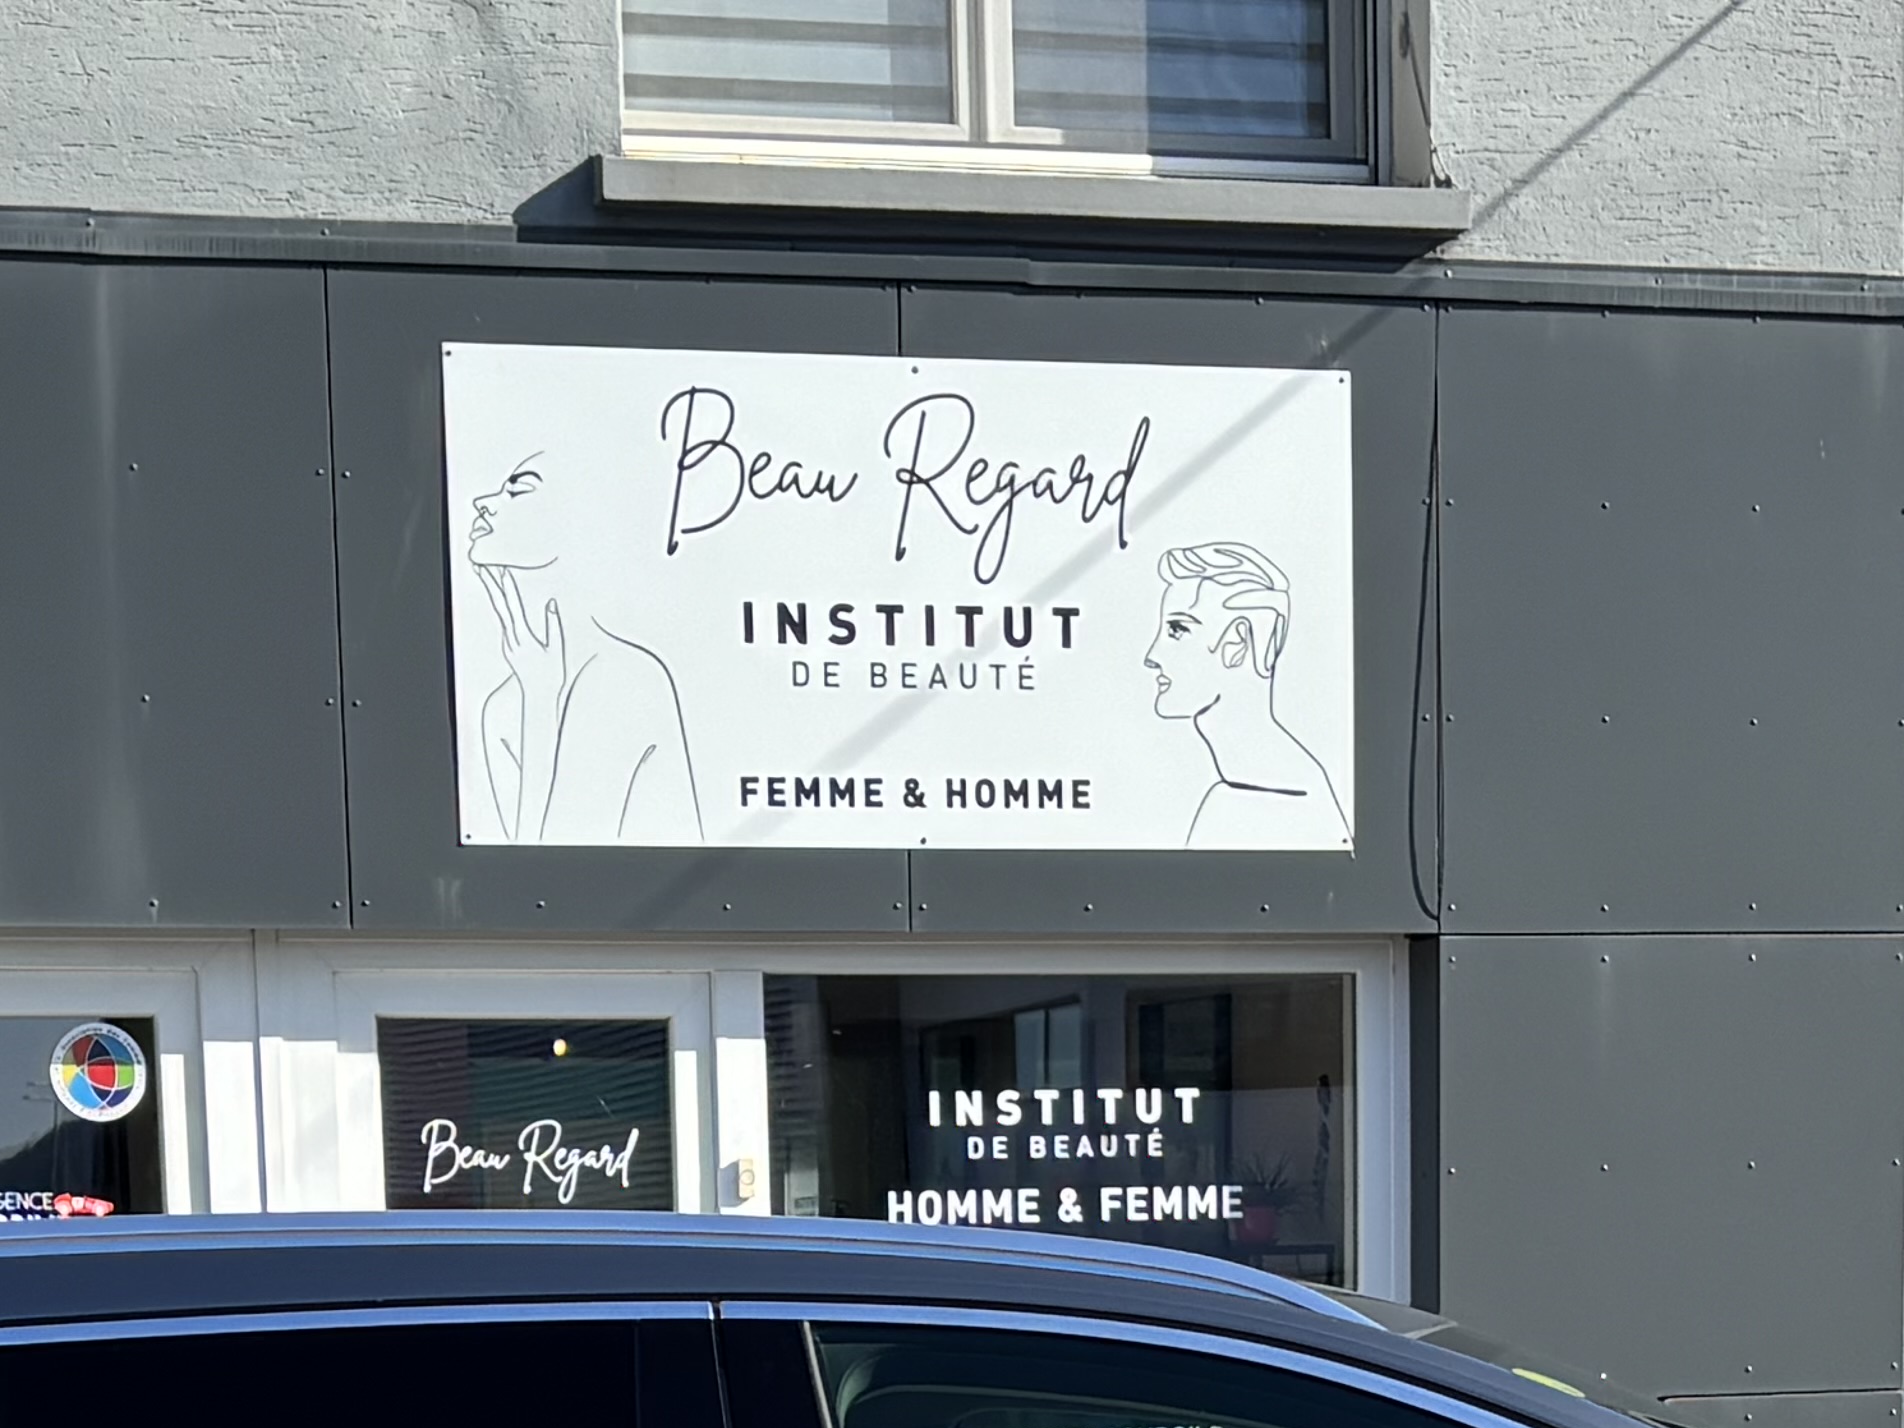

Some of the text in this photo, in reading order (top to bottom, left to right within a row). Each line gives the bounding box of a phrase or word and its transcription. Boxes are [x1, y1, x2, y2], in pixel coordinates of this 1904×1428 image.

[661, 386, 1151, 584] Beau Regard
[744, 602, 1080, 649] INSTITUT
[792, 656, 1035, 691] DE BEAUTÉ
[741, 777, 1091, 809] FEMME & HOMME
[929, 1088, 1201, 1126] INSTITUT
[421, 1118, 639, 1204] Beau Regard
[967, 1128, 1163, 1160] DE BEAUTÉ
[888, 1185, 1244, 1225] HOMME & FEMME
